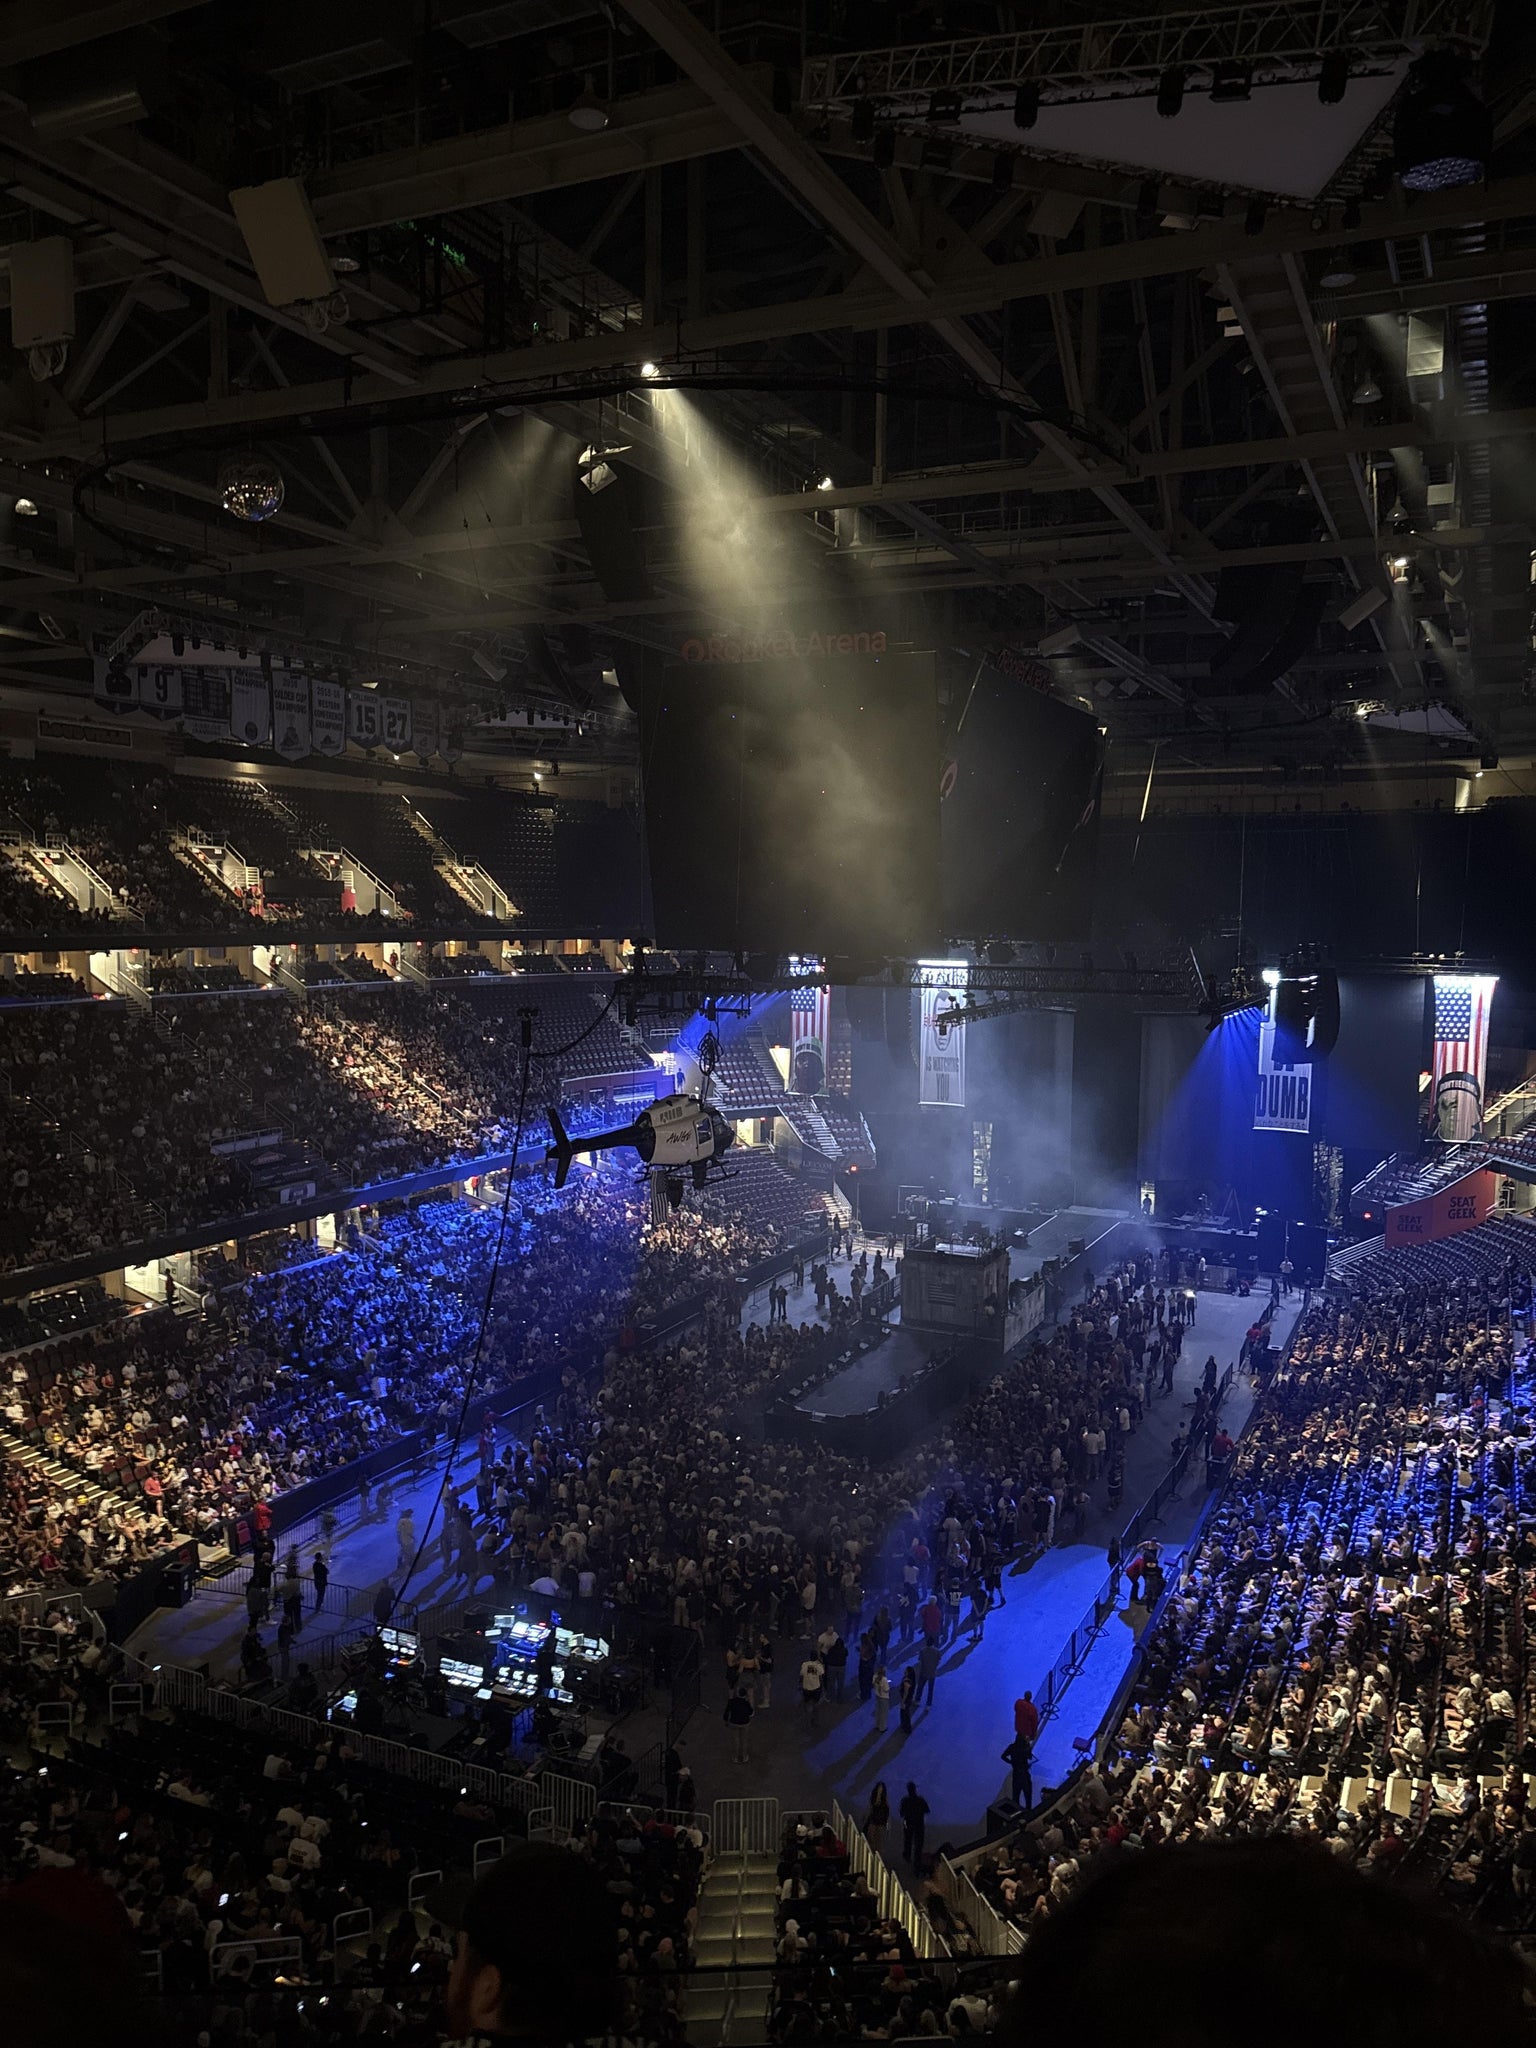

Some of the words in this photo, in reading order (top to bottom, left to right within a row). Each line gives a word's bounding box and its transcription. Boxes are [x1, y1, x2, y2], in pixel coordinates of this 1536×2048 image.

[805, 630, 887, 656] Arena
[356, 705, 376, 734] 15
[387, 710, 407, 740] 27
[936, 1073, 950, 1102] YOU
[1256, 1074, 1308, 1119] DUMB
[1448, 1208, 1477, 1220] GEEK
[1449, 1195, 1477, 1208] SEAT
[1397, 1224, 1423, 1234] GEEK
[1398, 1215, 1422, 1224] SEAT
